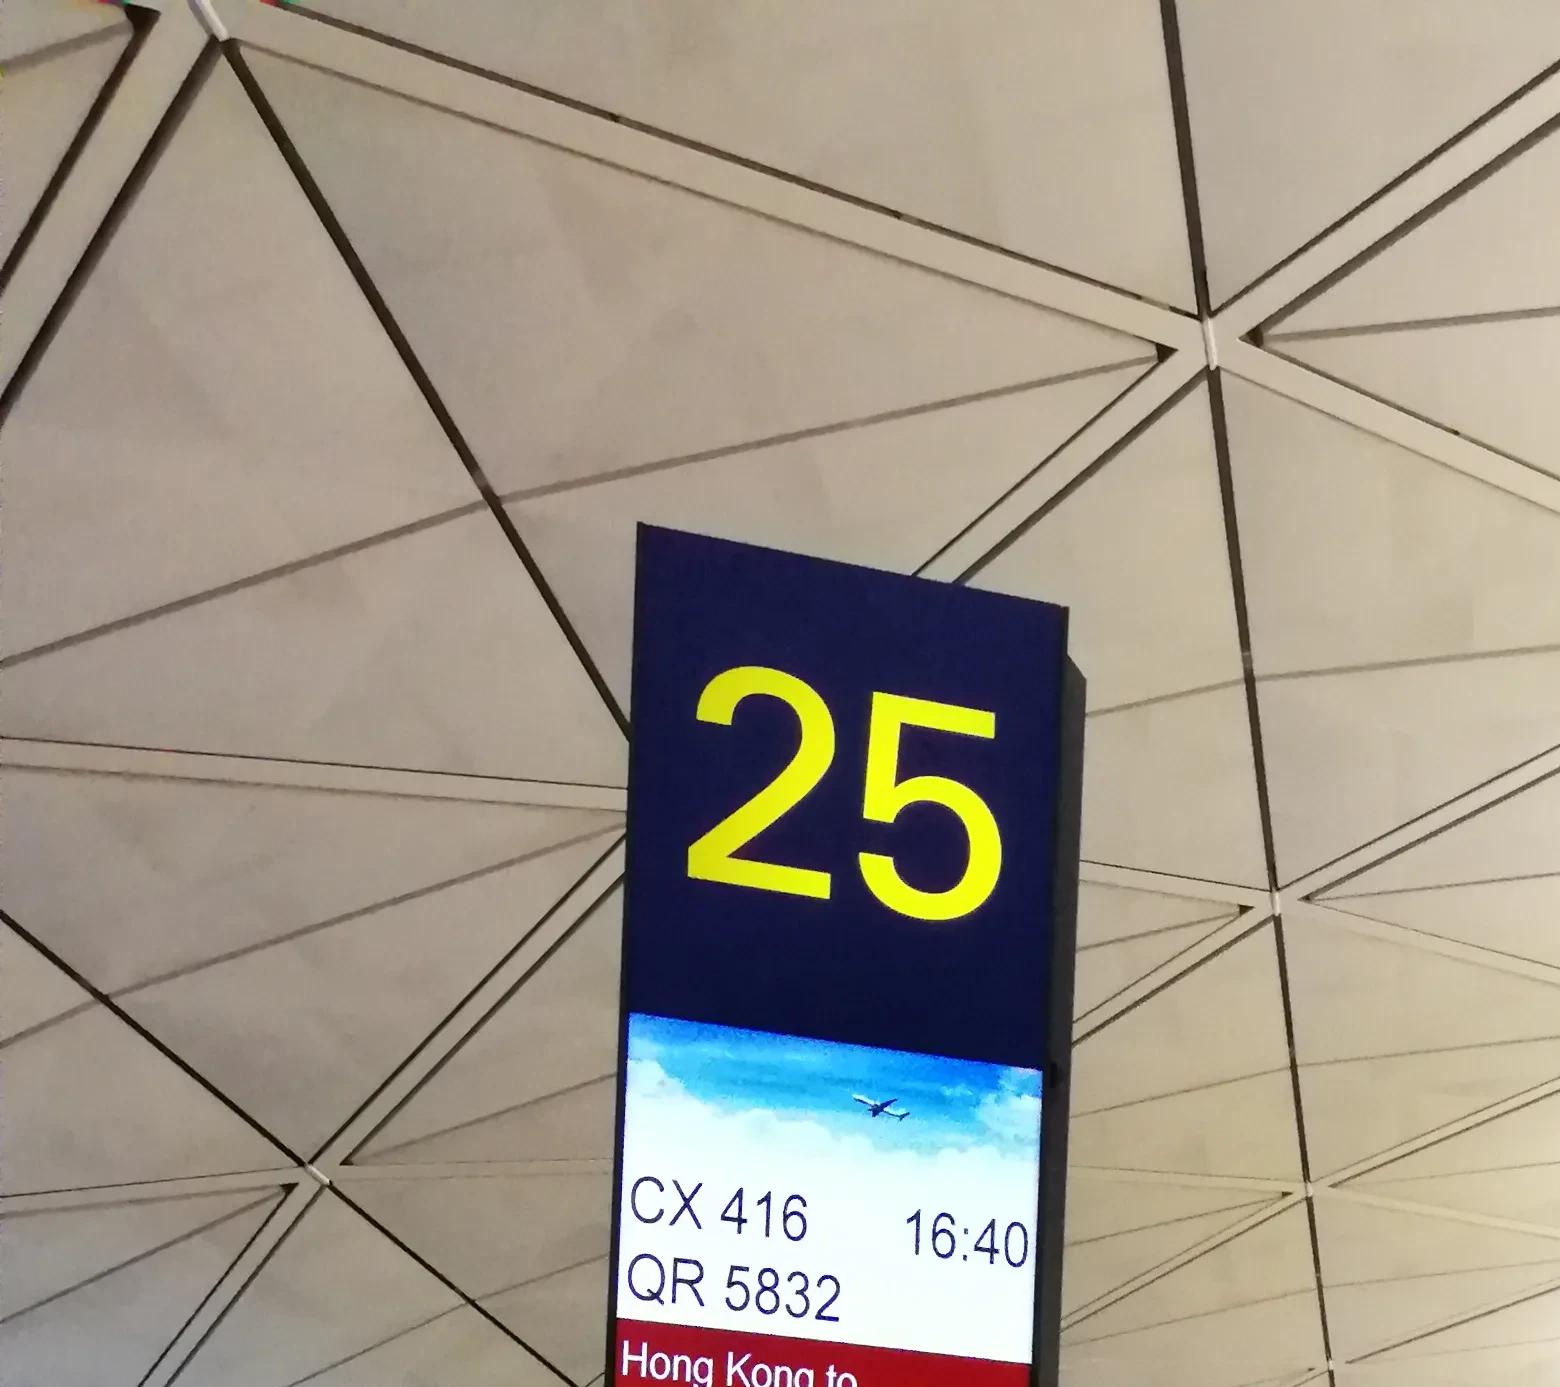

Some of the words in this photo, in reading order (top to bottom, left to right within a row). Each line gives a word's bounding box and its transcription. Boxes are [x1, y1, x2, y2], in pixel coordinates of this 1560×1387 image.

[687, 665, 1002, 921] 25
[630, 1175, 703, 1230] CX
[720, 1187, 808, 1242] 416
[906, 1208, 1029, 1268] 16:40
[627, 1253, 705, 1307] QR
[725, 1264, 841, 1323] 5832
